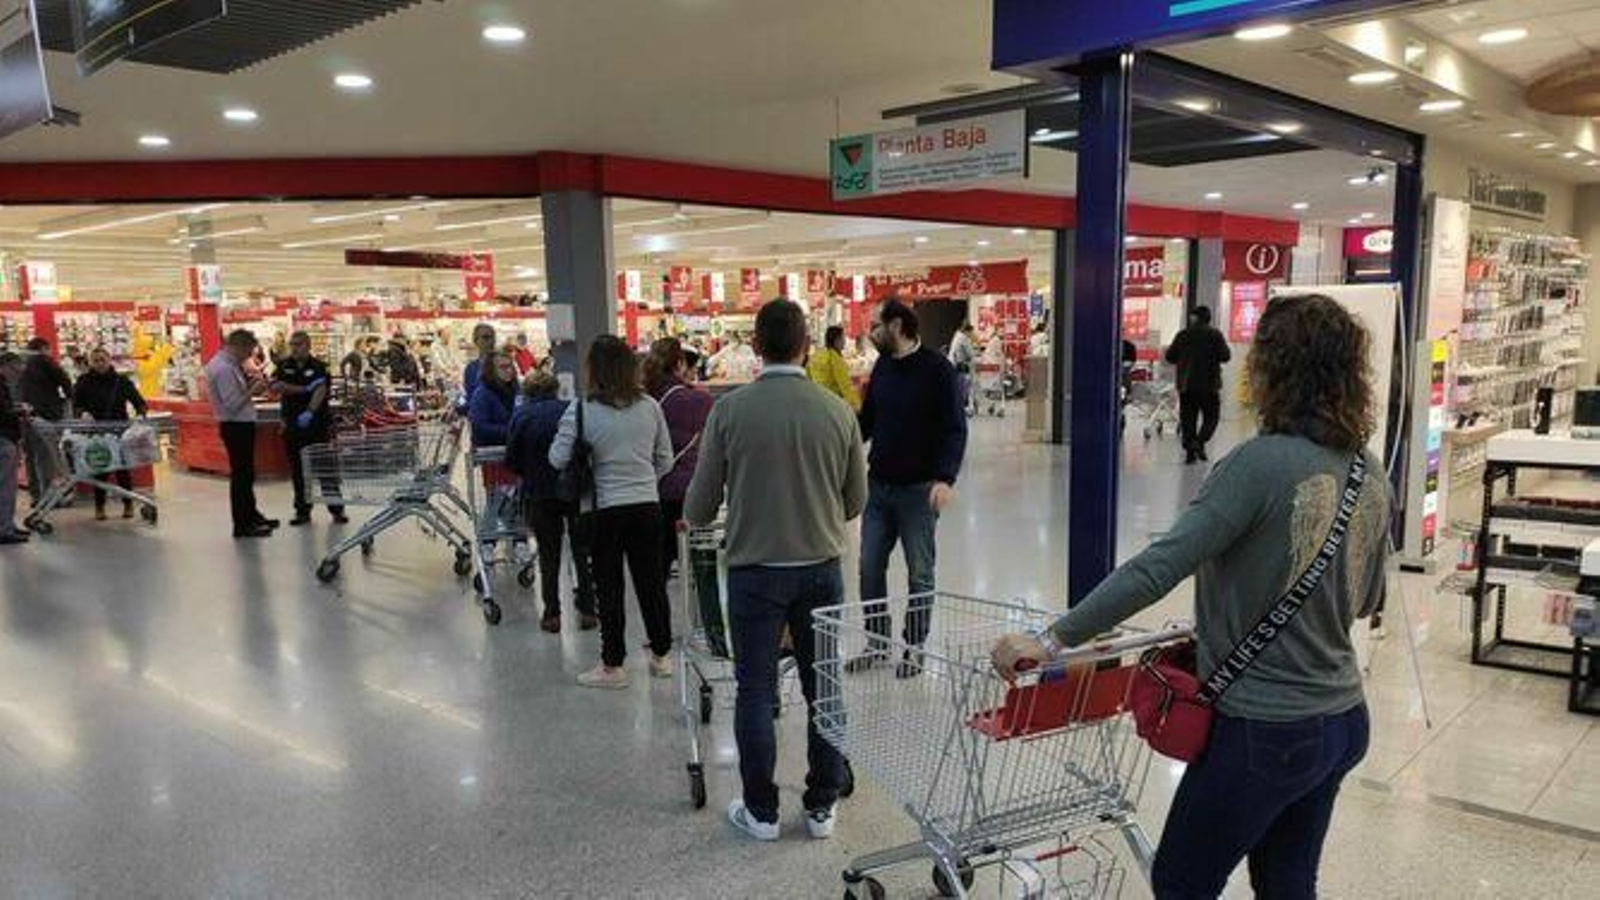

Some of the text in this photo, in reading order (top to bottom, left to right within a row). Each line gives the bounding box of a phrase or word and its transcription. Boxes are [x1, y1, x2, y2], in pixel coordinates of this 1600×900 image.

[943, 125, 987, 150] Baja
[1228, 621, 1277, 670] LIFE'S
[1268, 556, 1329, 625] GETTING
